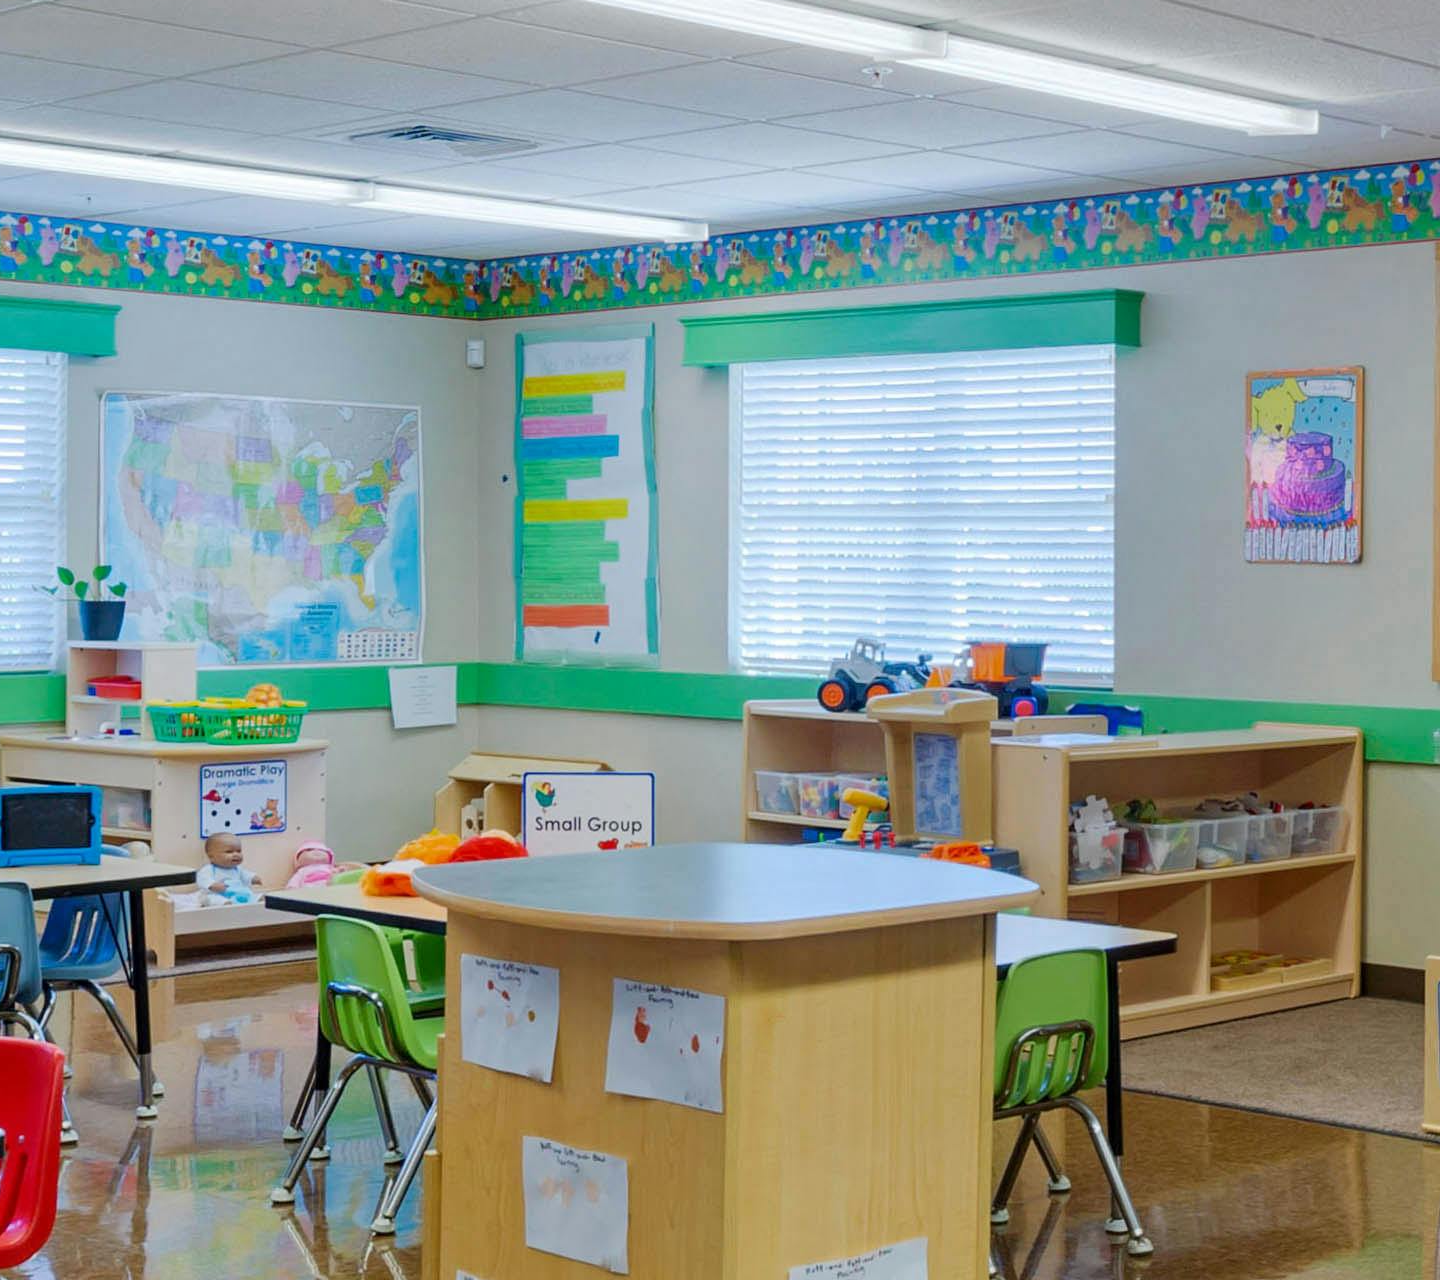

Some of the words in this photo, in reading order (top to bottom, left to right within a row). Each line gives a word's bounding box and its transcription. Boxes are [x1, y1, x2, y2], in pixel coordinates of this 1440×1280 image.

[203, 766, 256, 779] Dramatic
[260, 765, 285, 776] Play
[536, 816, 581, 831] Small
[588, 817, 642, 835] Group
